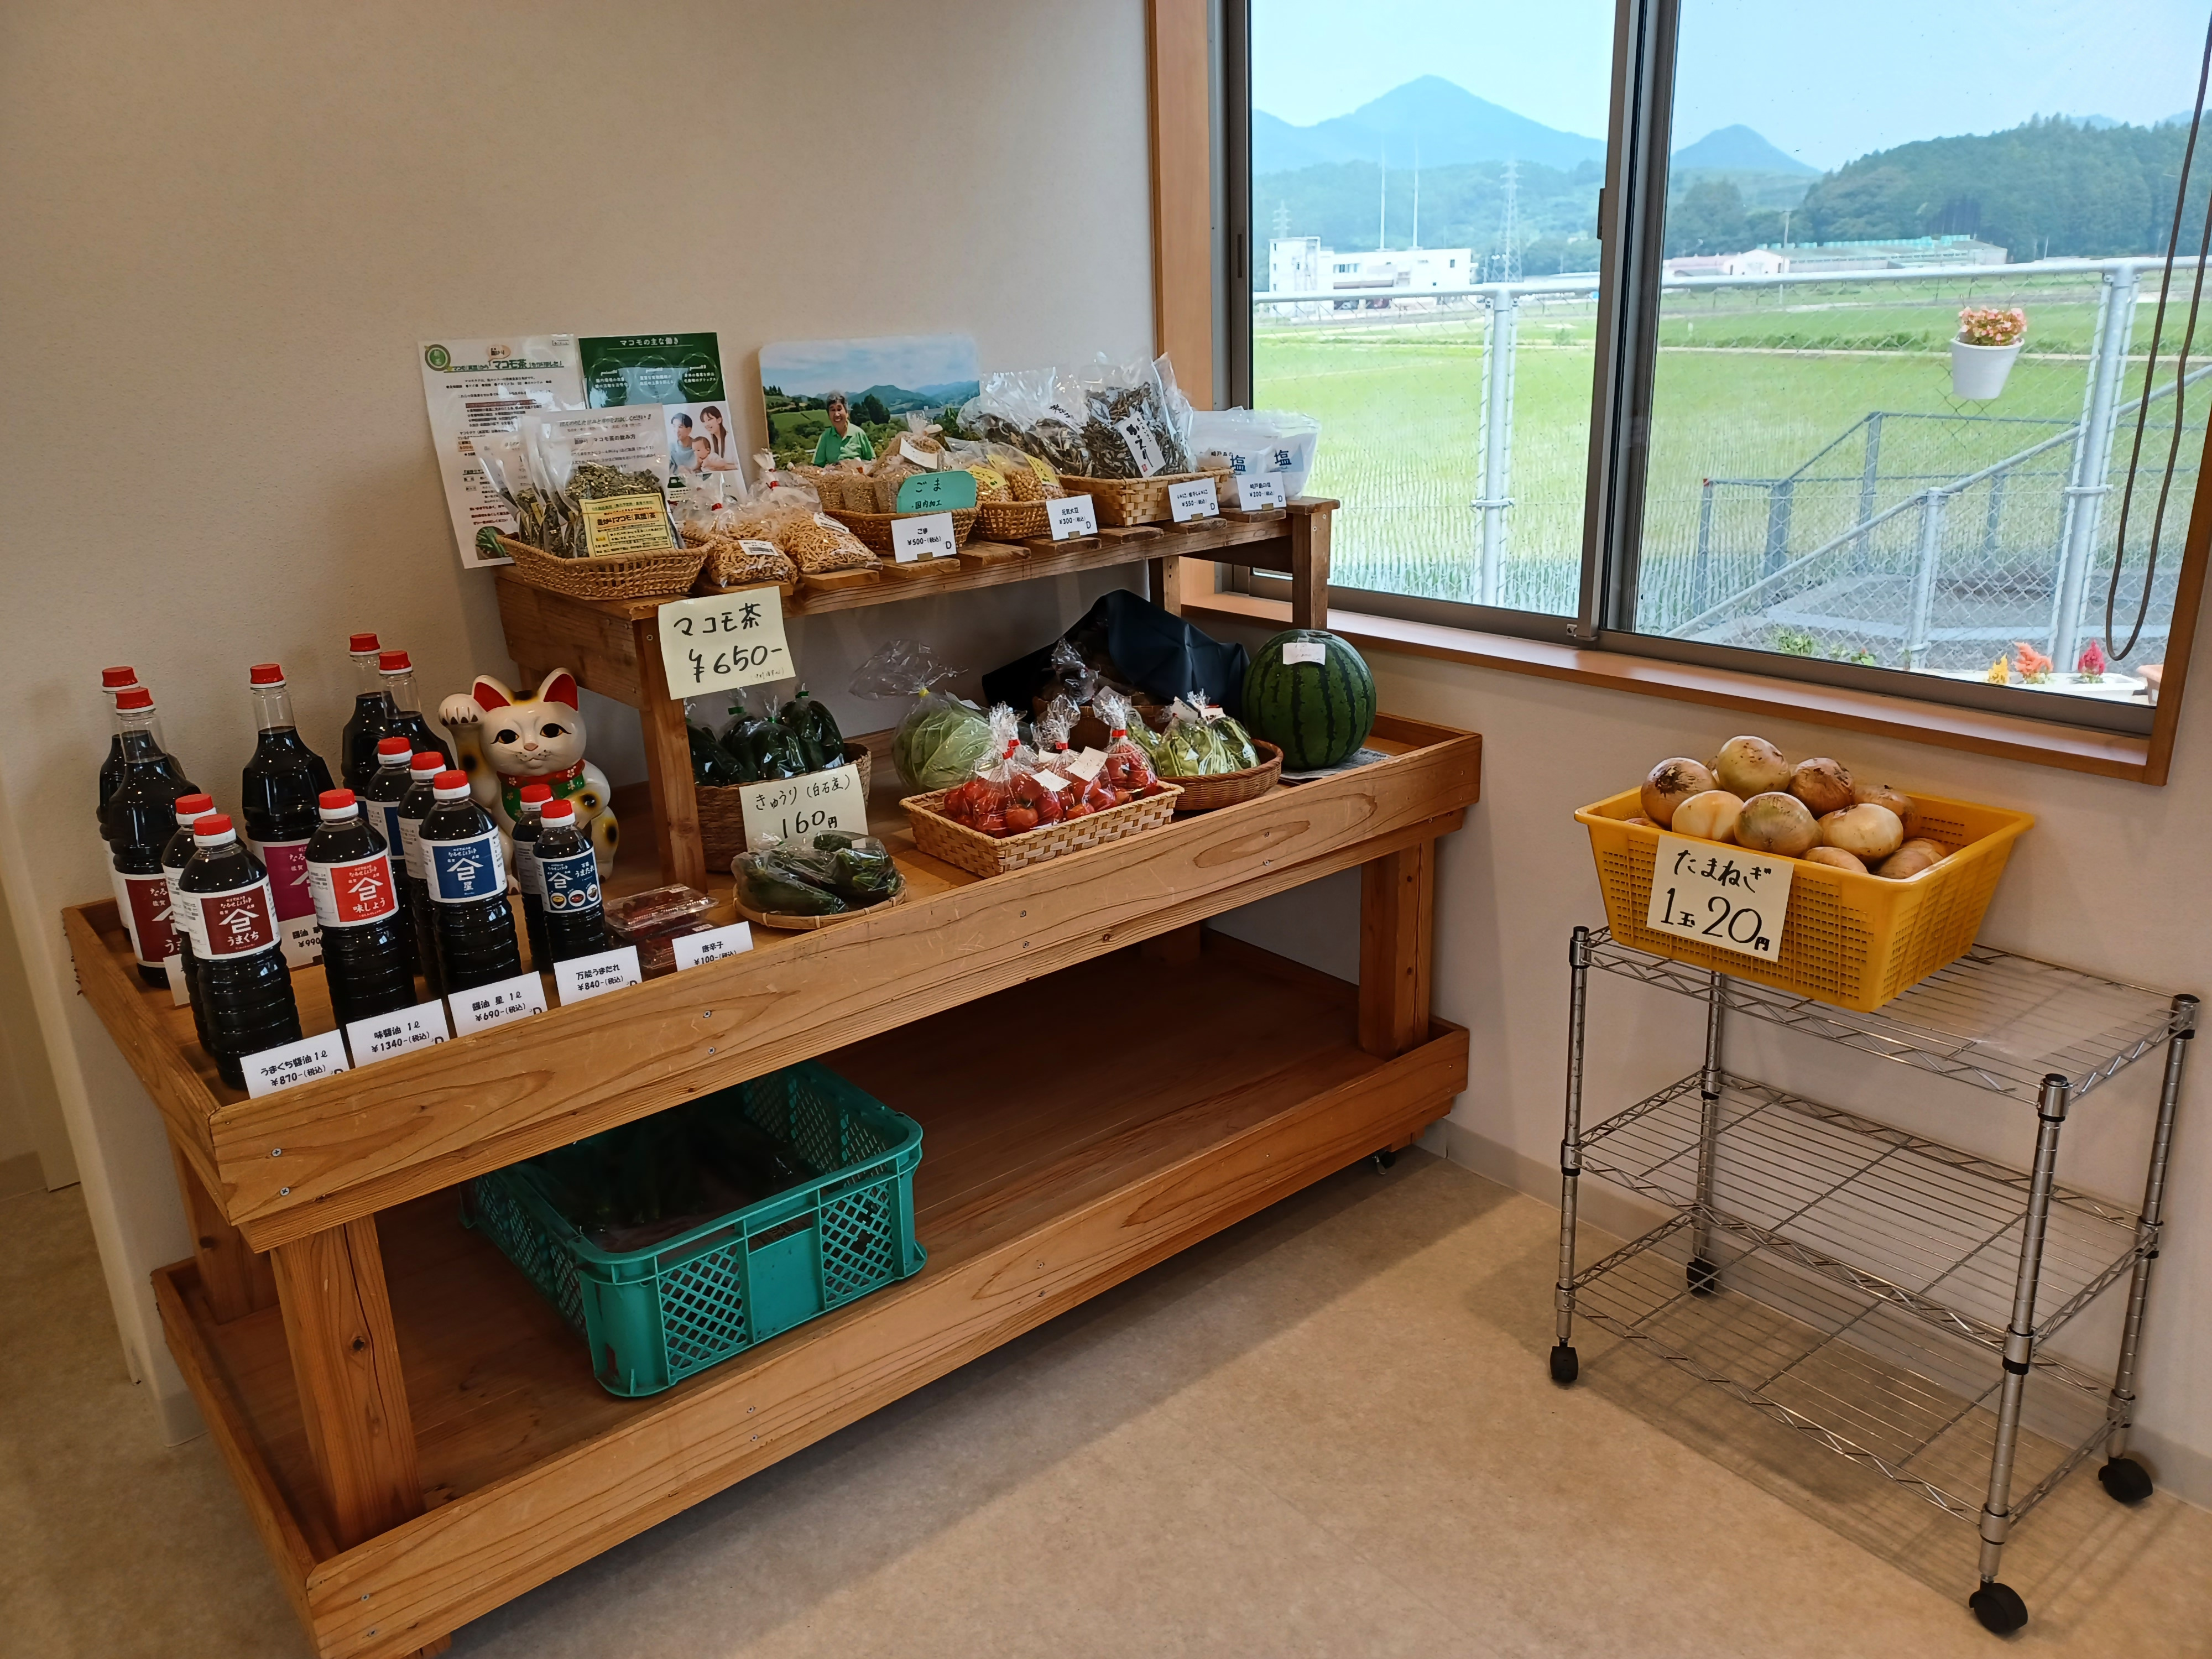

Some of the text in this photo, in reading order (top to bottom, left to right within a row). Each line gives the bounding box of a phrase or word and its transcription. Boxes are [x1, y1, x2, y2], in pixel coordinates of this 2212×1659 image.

[1230, 454, 1246, 472] 塩
[1274, 449, 1292, 466] 塩
[915, 477, 942, 493] ごま
[1061, 508, 1080, 516] 元気大豆
[1210, 502, 1215, 510] D
[1086, 521, 1092, 529] D
[945, 541, 952, 550] D
[674, 602, 762, 637] マコモ茶
[755, 786, 797, 811] きゅうり
[781, 810, 838, 839] 160円
[1673, 849, 1772, 894] たまねぎ
[463, 880, 474, 891] 星
[227, 931, 259, 947] うまくち
[702, 941, 724, 953] 唐辛子
[494, 995, 504, 1005] 星
